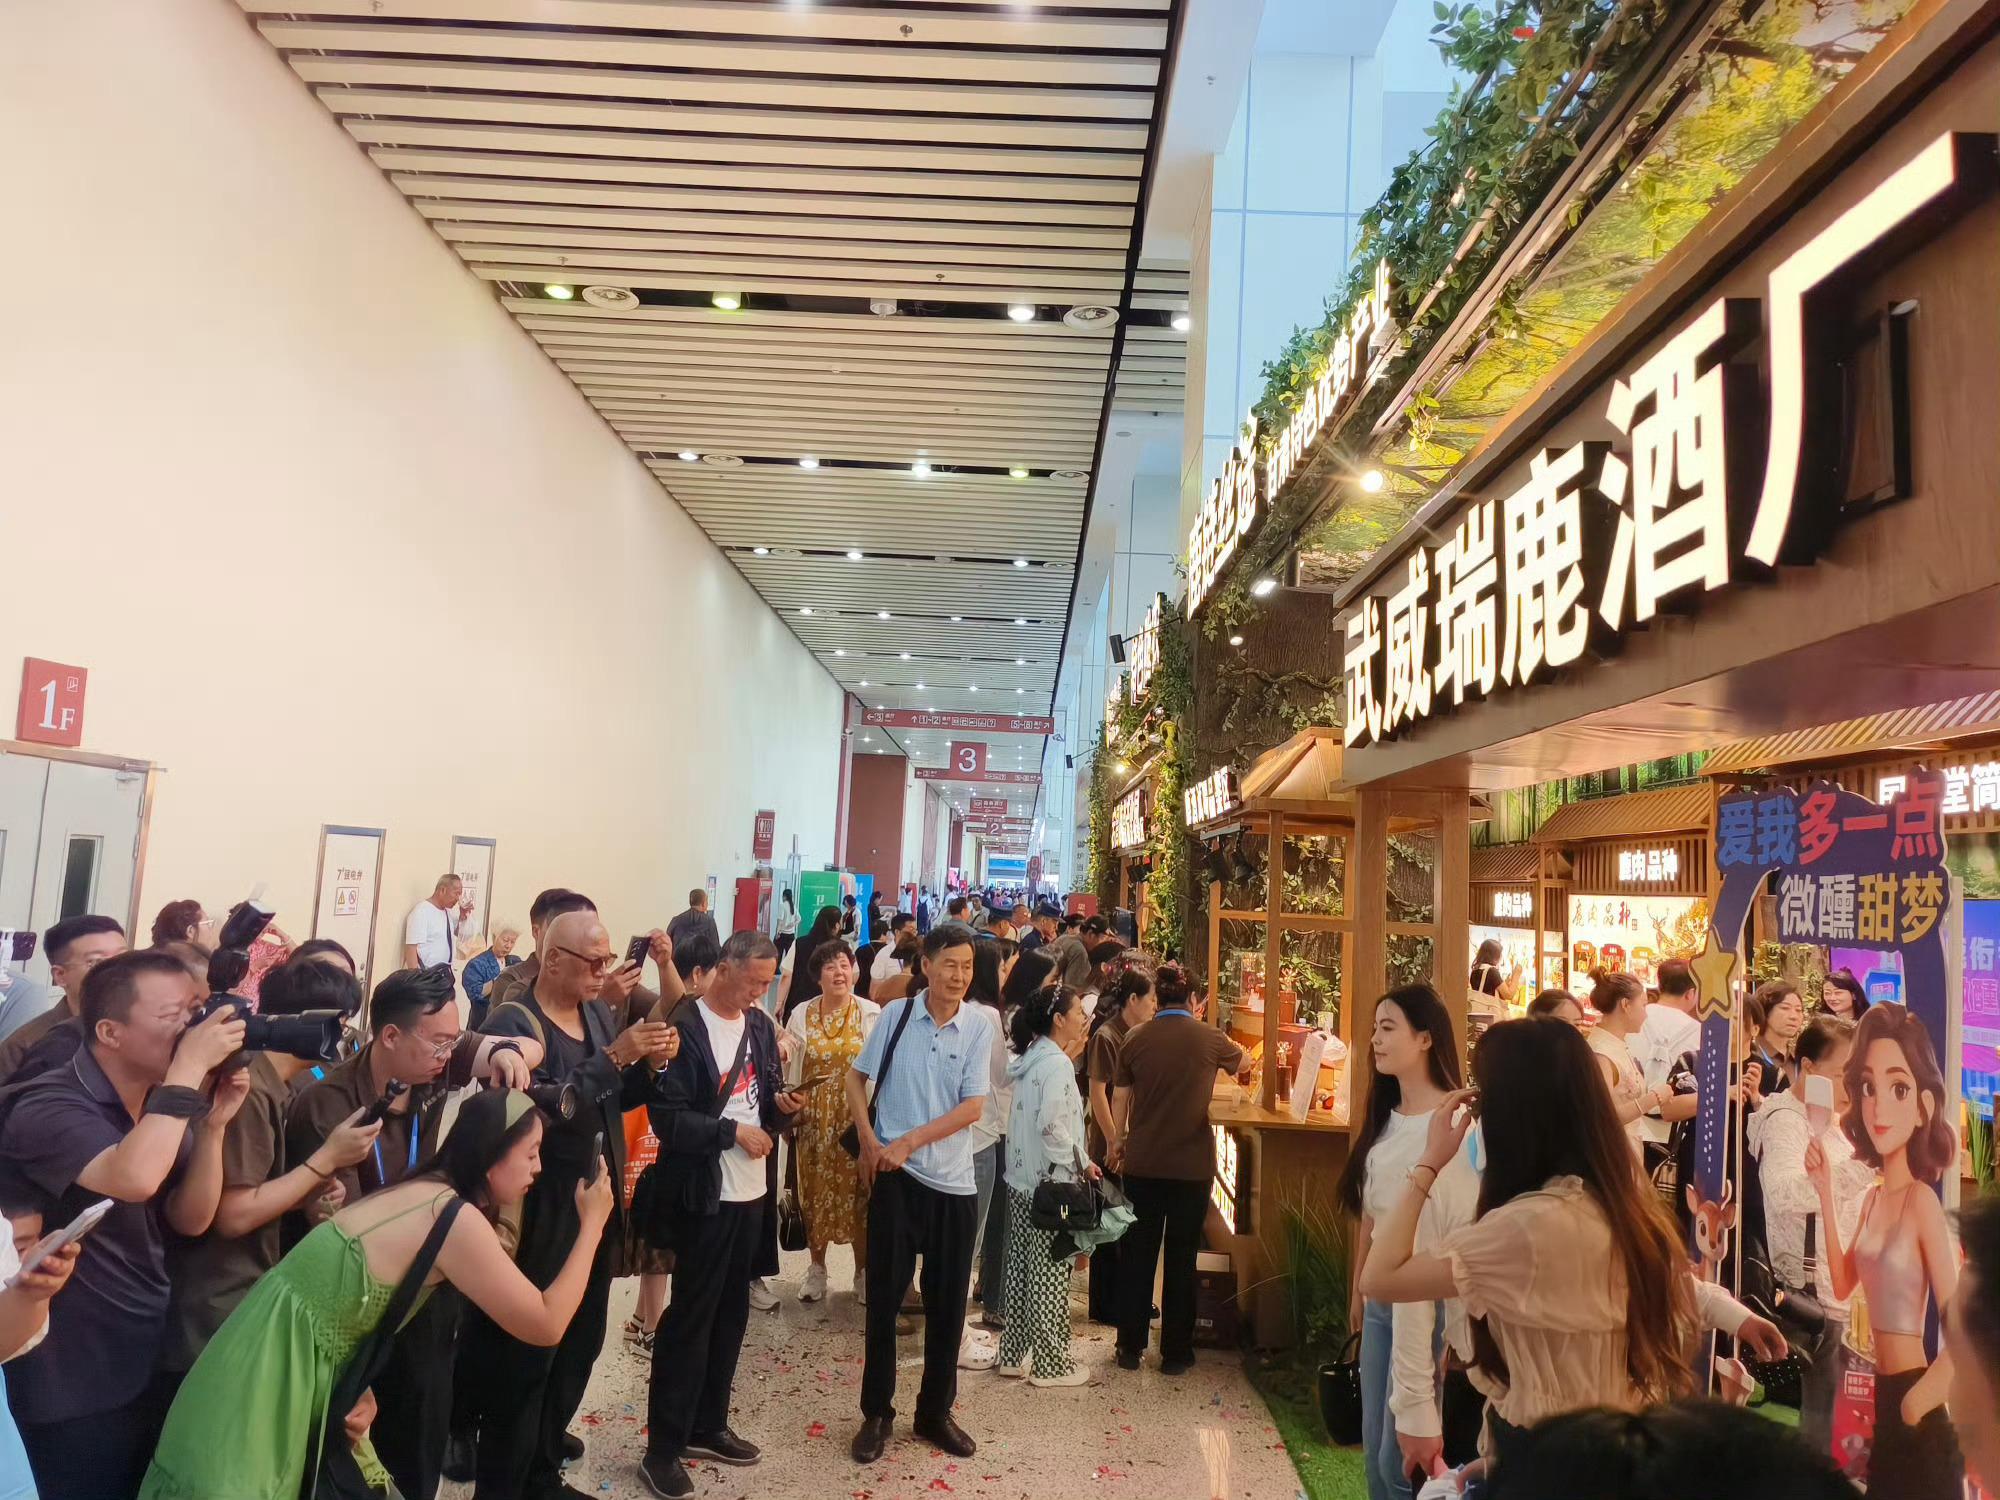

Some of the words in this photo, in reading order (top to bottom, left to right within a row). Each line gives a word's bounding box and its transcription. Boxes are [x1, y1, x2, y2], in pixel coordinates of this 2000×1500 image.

[1267, 257, 1392, 503] 甘肃特色优势产业
[1344, 131, 1955, 747] 武威瑞鹿酒厂
[958, 748, 977, 773] 3
[990, 822, 999, 835] 2
[1717, 777, 1939, 866] 爱我多一点
[1619, 848, 1679, 881] 鹿肉品种
[1780, 871, 1944, 944] 微醺甜梦
